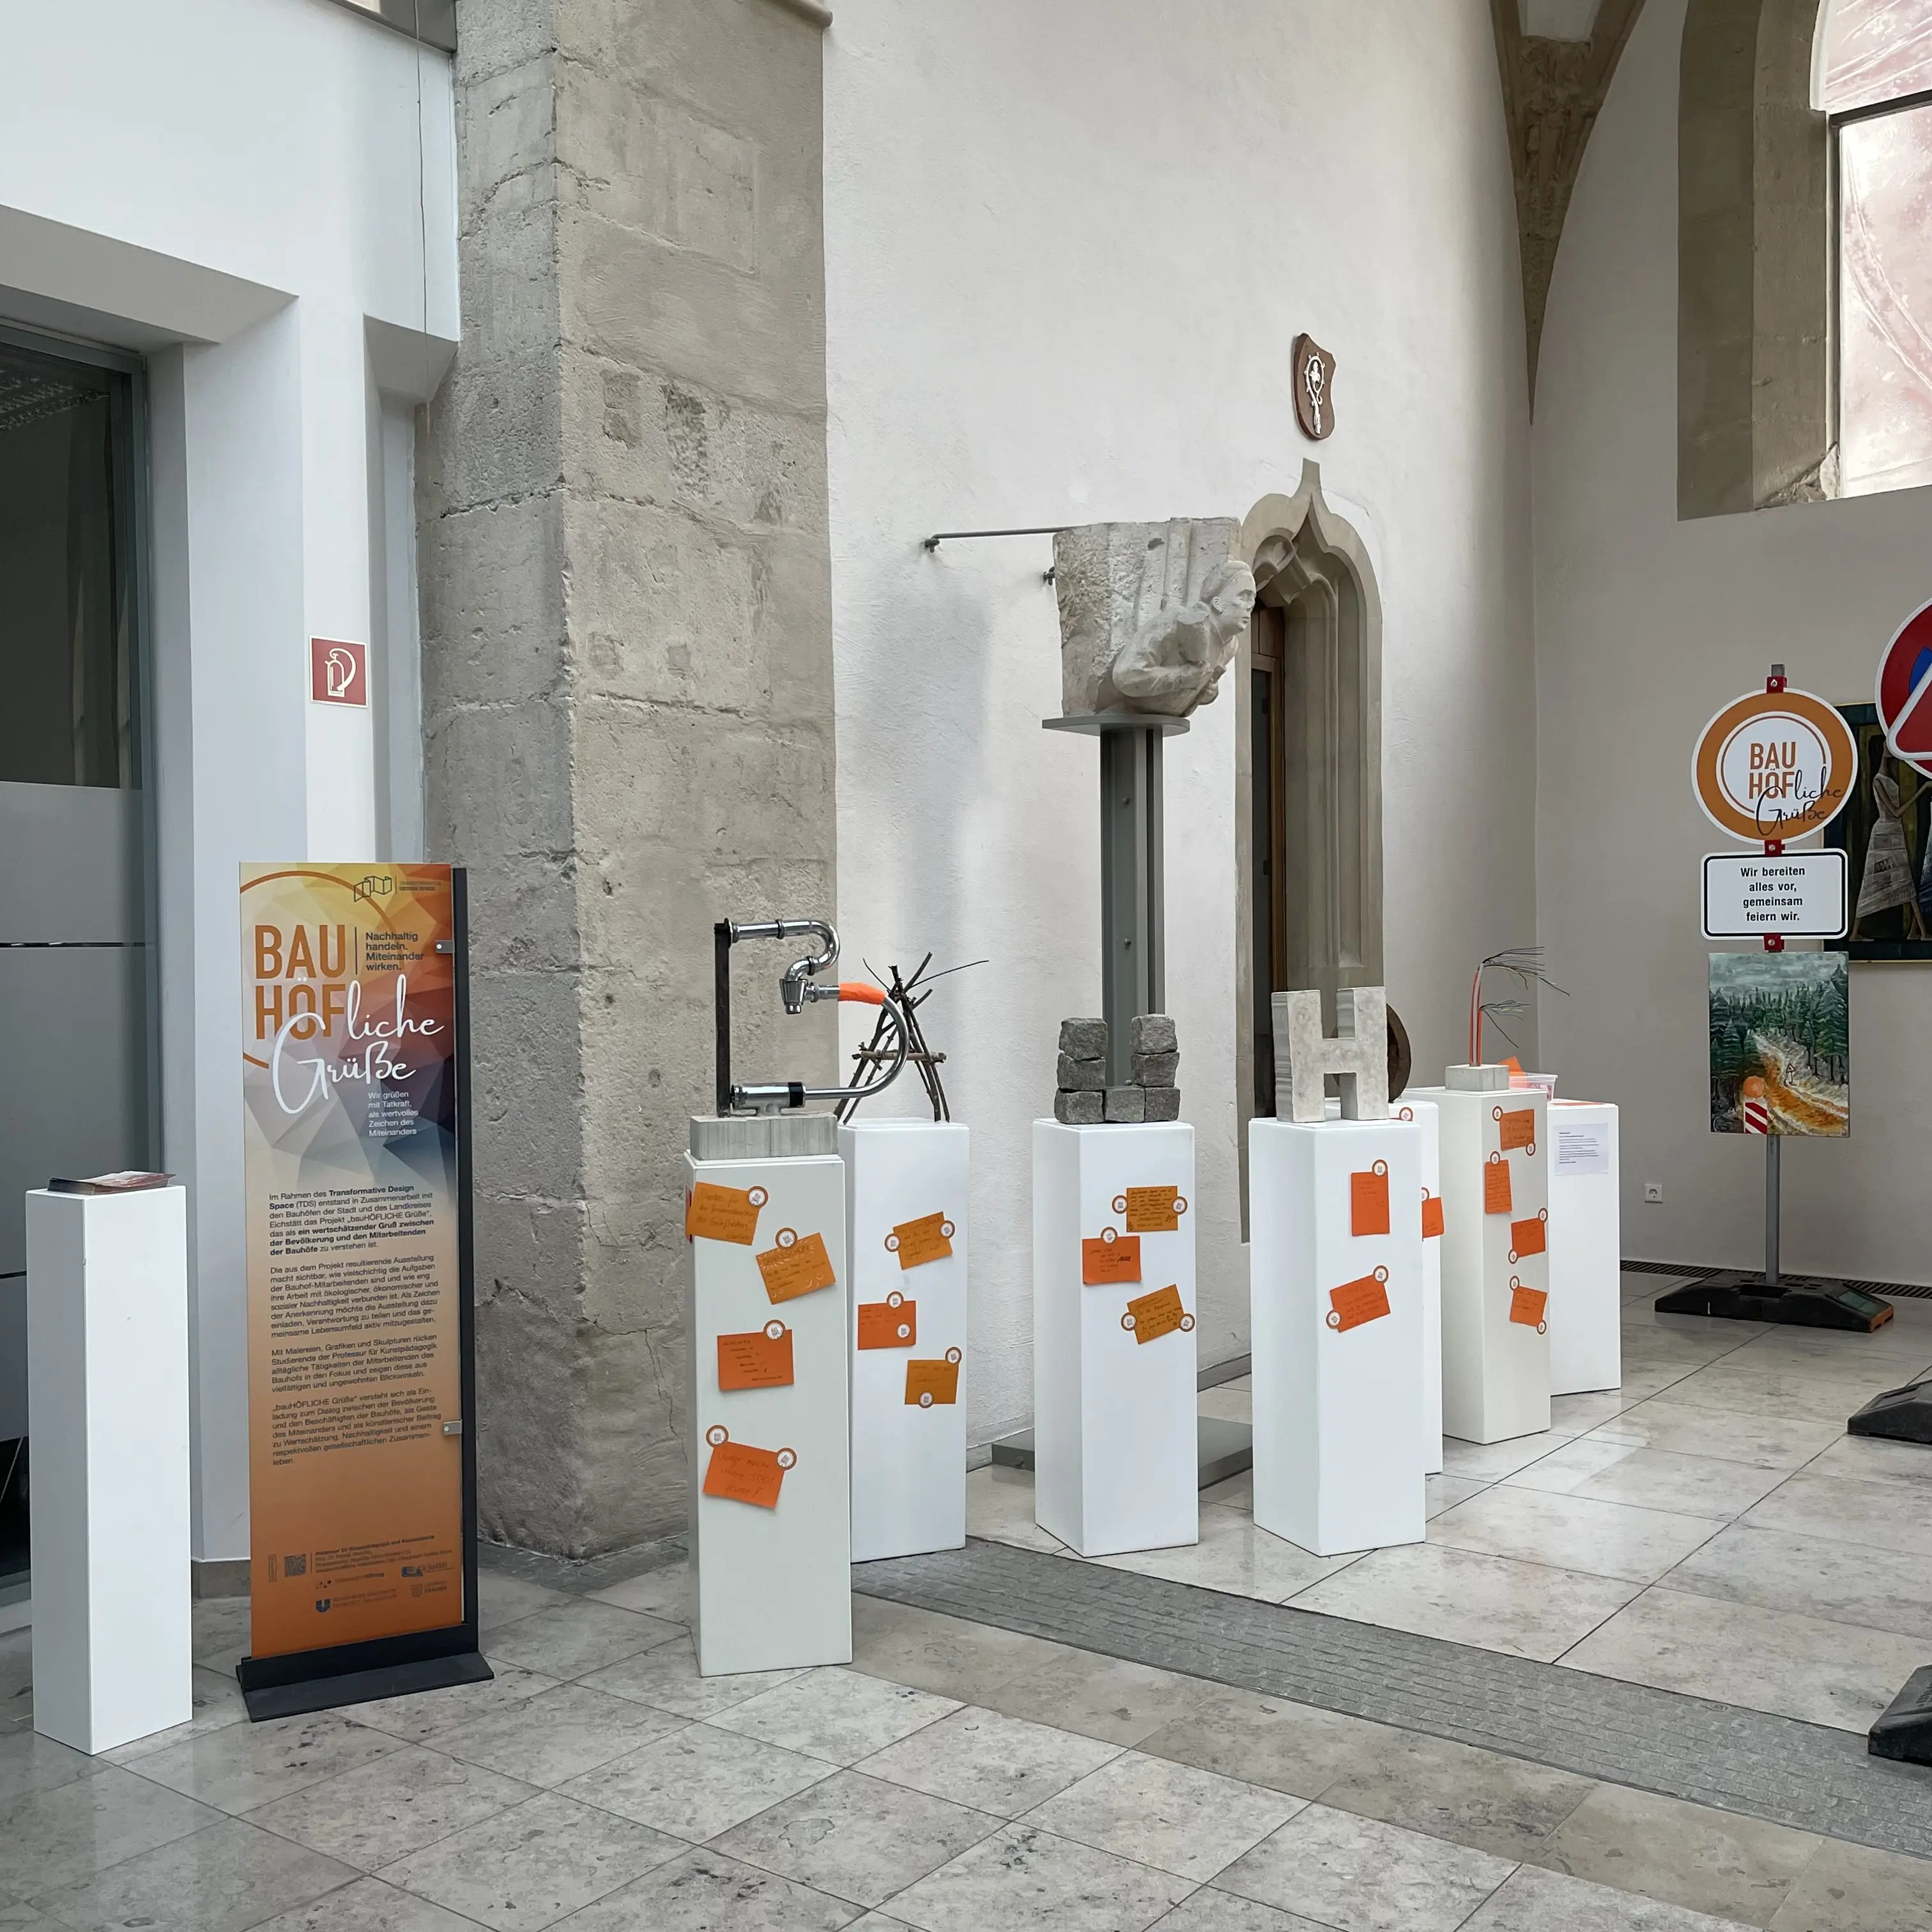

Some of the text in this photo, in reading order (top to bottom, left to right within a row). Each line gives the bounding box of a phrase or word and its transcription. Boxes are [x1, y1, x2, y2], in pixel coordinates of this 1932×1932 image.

[1749, 742, 1796, 770] BAU
[1756, 786, 1829, 836] Grüße
[1740, 866, 1805, 876] Wir bereiten
[1749, 882, 1797, 893] alles vor,
[1743, 898, 1803, 908] gemeinsam
[1746, 912, 1800, 922] feiern wir.
[365, 932, 418, 944] Nachhaltig
[365, 942, 408, 951] handeln.
[256, 924, 345, 979] BAU
[366, 952, 424, 961] Miteinander
[366, 963, 402, 971] wirken.
[273, 1013, 417, 1114] Grüße
[383, 1091, 409, 1100] grüßen
[382, 1100, 411, 1109] Tatkraft,
[381, 1109, 418, 1117] wertvolles
[369, 1128, 417, 1137] Miteinanders
[387, 1184, 414, 1193] Design
[268, 1202, 295, 1211] Space
[295, 1200, 317, 1209] (TDS)
[319, 1216, 346, 1225] Projekt
[284, 1246, 318, 1254] Bauhöfe
